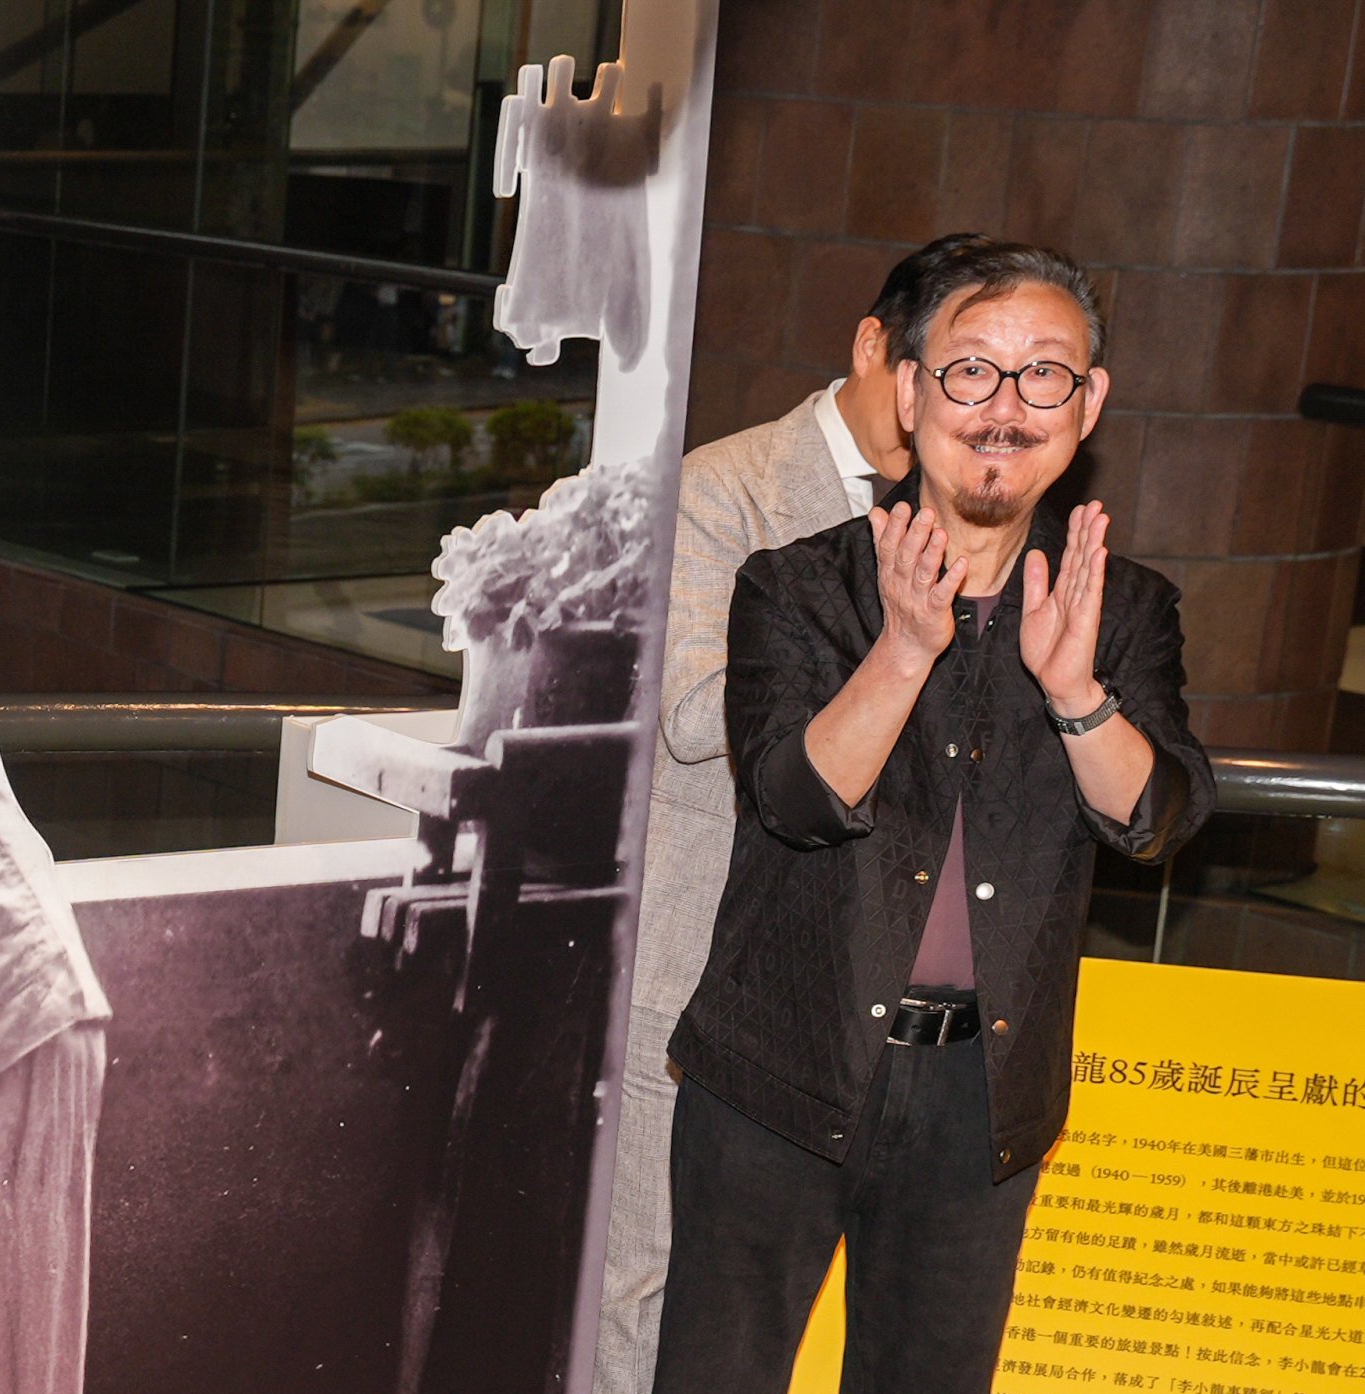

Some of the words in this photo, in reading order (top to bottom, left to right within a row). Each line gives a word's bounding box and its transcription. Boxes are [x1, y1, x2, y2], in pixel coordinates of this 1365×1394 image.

[1072, 1051, 1365, 1109] 龍85歲誕辰呈獻的
